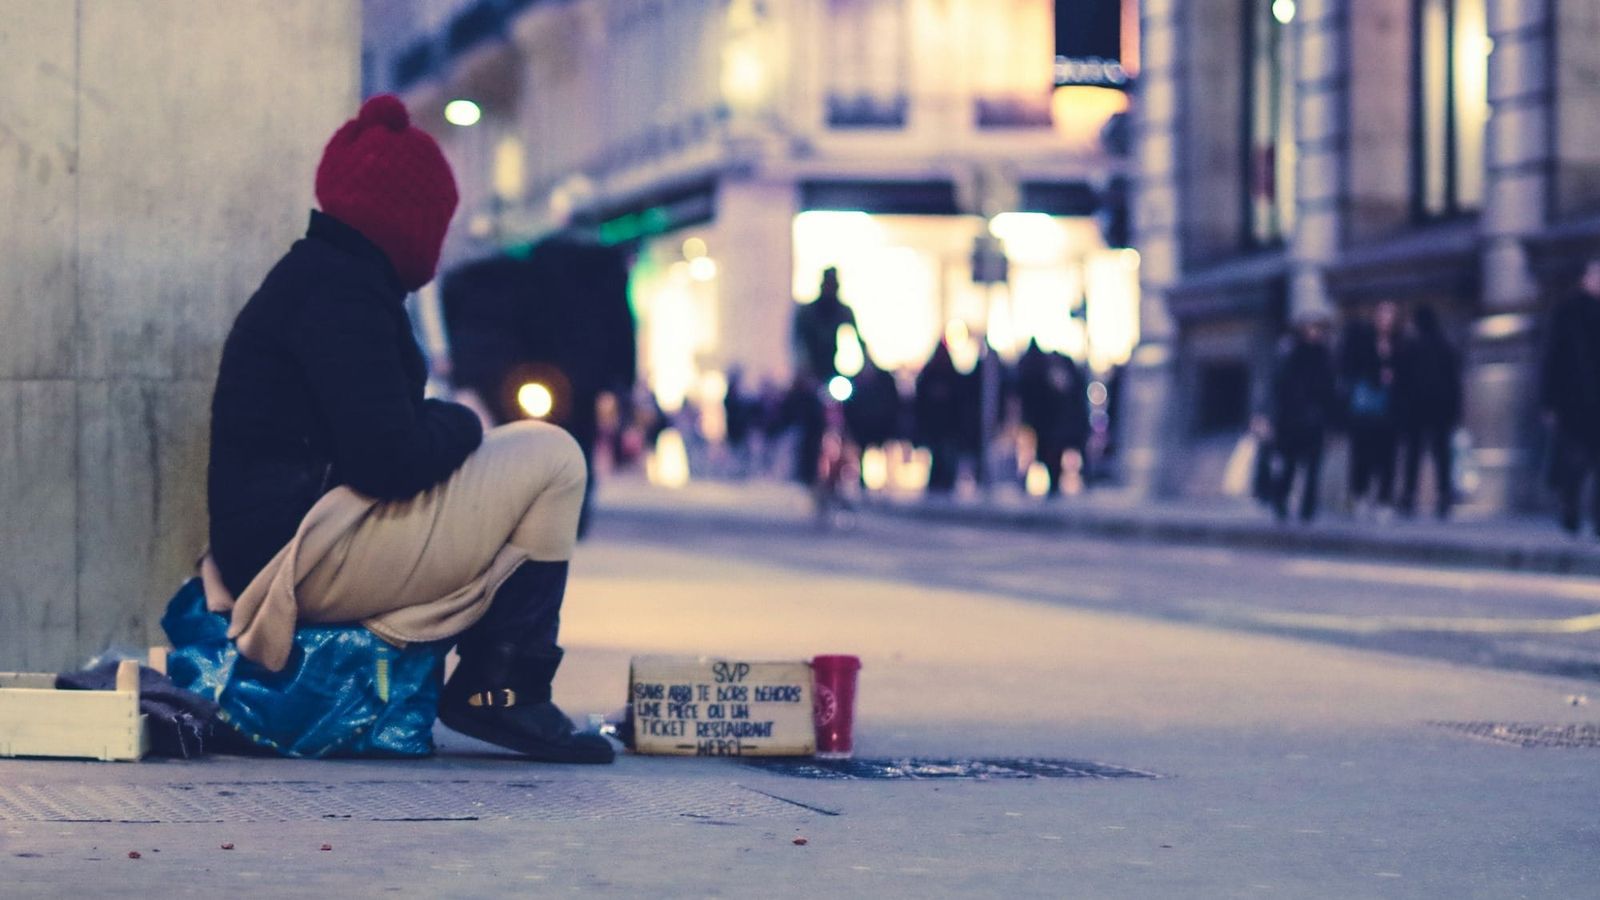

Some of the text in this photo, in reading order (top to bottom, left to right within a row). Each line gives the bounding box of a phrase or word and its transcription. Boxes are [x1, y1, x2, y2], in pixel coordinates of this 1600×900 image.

[712, 661, 750, 683] SVP
[707, 703, 725, 719] OU
[641, 718, 774, 738] TICKET RESTAURANT
